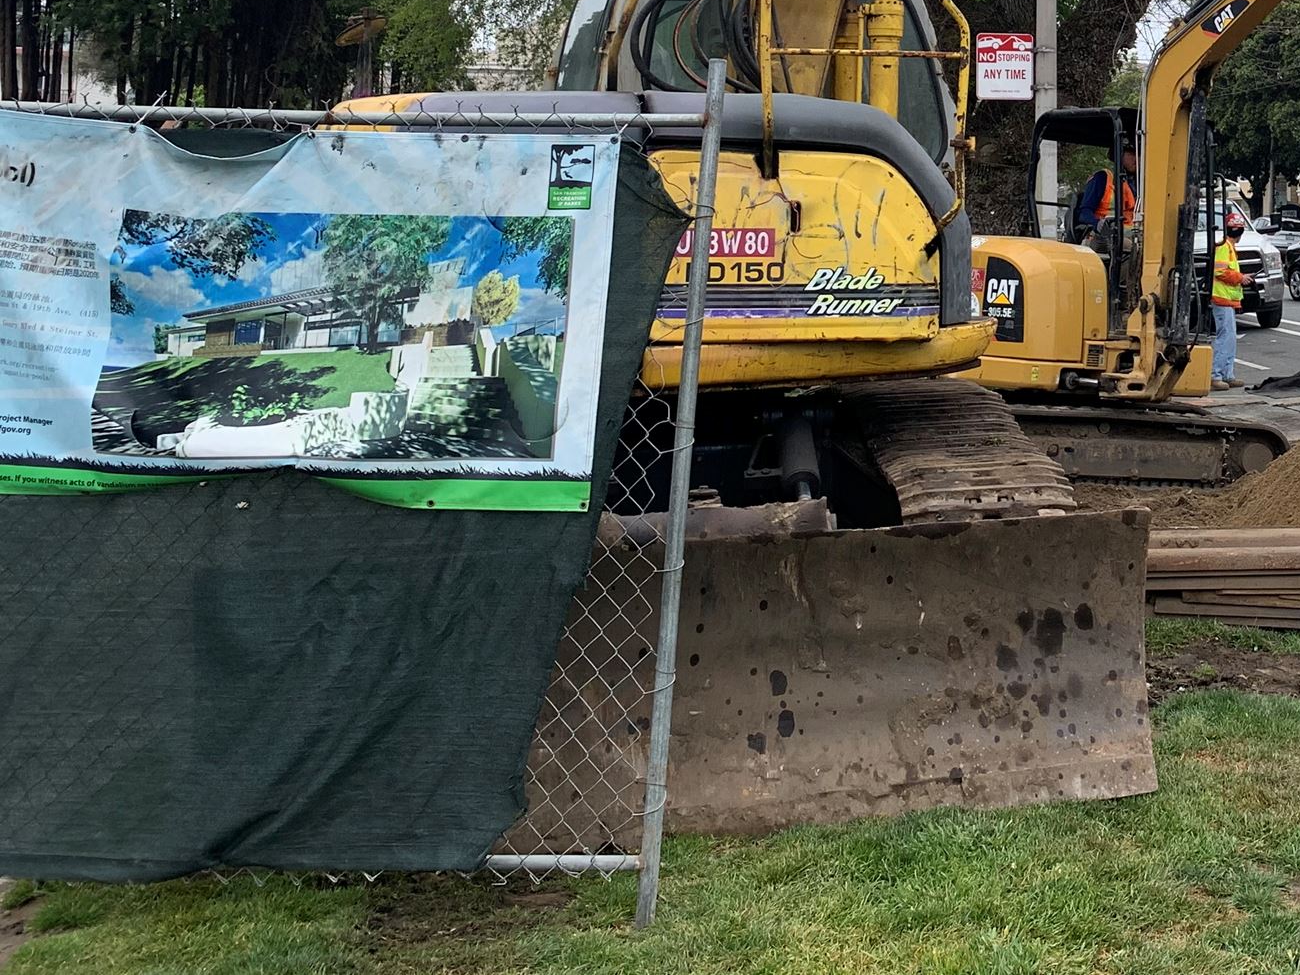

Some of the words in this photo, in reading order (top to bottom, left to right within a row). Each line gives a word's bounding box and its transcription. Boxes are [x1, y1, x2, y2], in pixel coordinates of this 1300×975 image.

[1214, 4, 1235, 33] CAT
[979, 52, 995, 62] NO
[998, 53, 1030, 62] STOPPING
[984, 68, 1002, 80] ANY
[1005, 69, 1026, 80] TIME
[804, 267, 884, 291] Blade
[986, 278, 1019, 305] CAT
[806, 294, 903, 316] Runner
[79, 309, 99, 319] (415)
[23, 416, 54, 426] Manager
[15, 474, 21, 482] If
[22, 476, 37, 484] you
[38, 476, 68, 485] witness
[69, 479, 86, 487] acts
[86, 479, 96, 487] of
